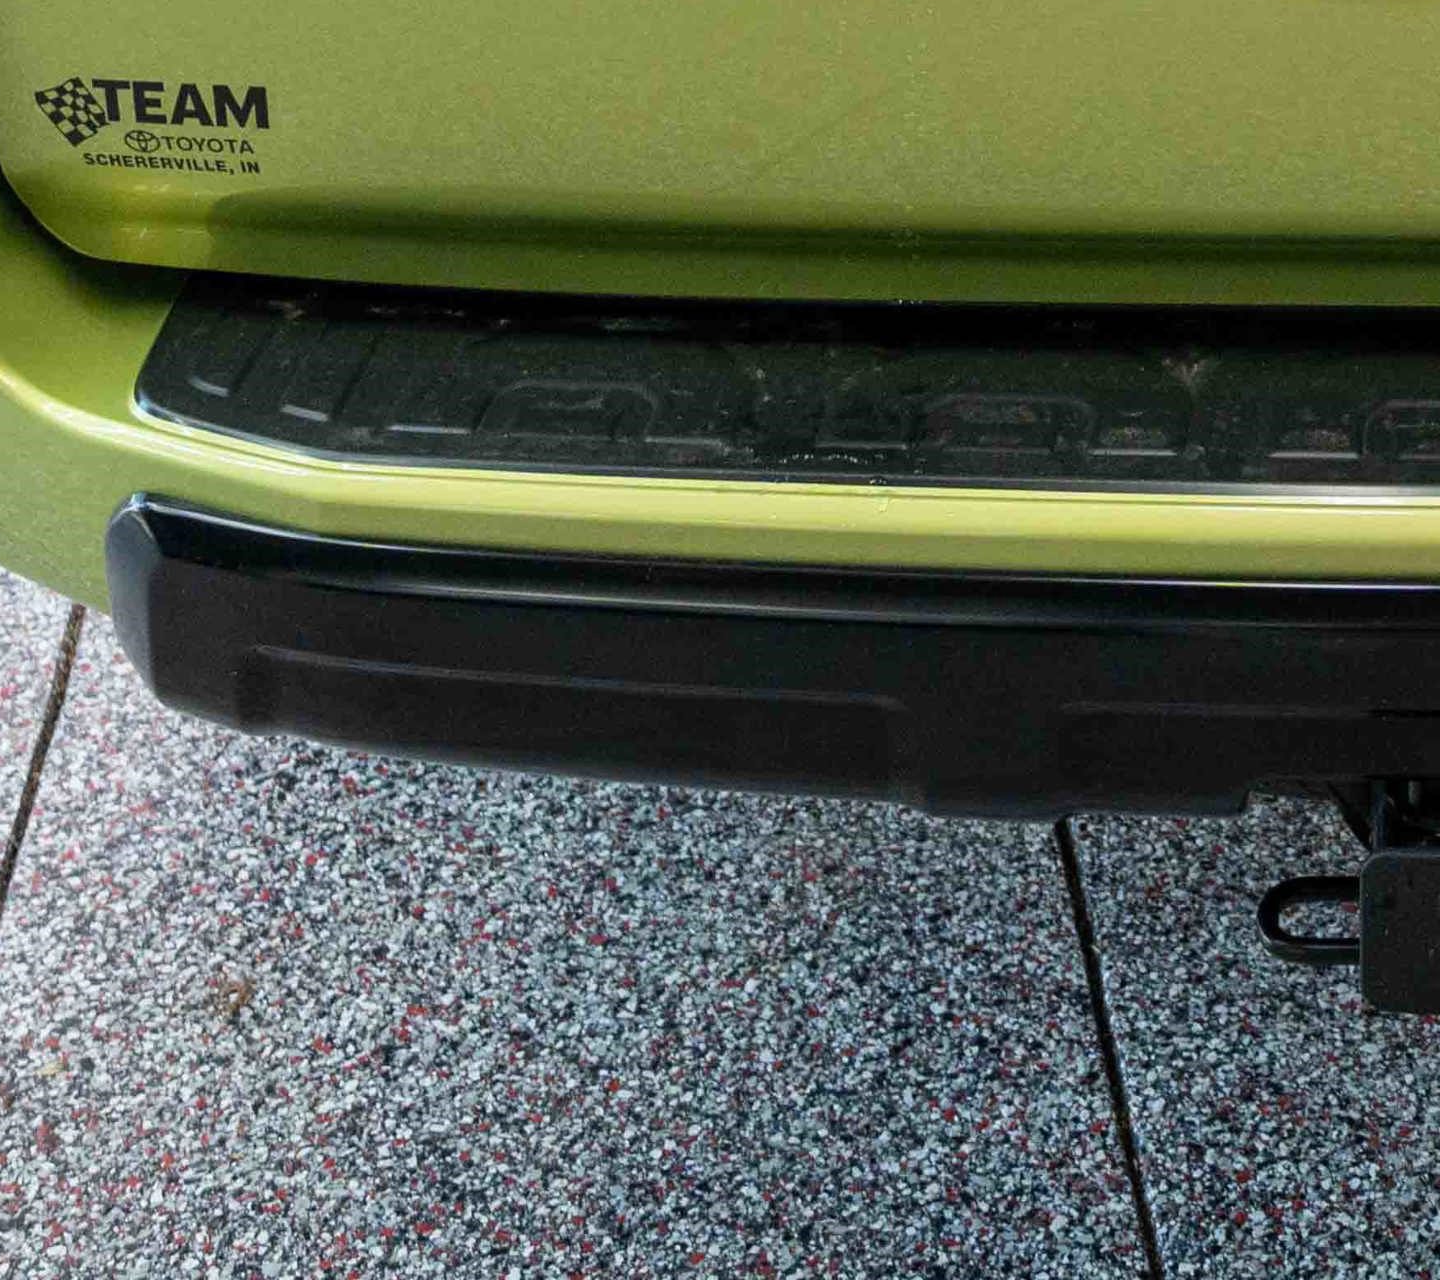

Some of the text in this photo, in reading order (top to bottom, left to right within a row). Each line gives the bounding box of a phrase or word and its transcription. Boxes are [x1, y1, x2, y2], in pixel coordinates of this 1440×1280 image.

[92, 78, 270, 130] TEAM
[160, 135, 255, 155] TOYOTA
[83, 152, 261, 175] SCHERERVILLE, IN
